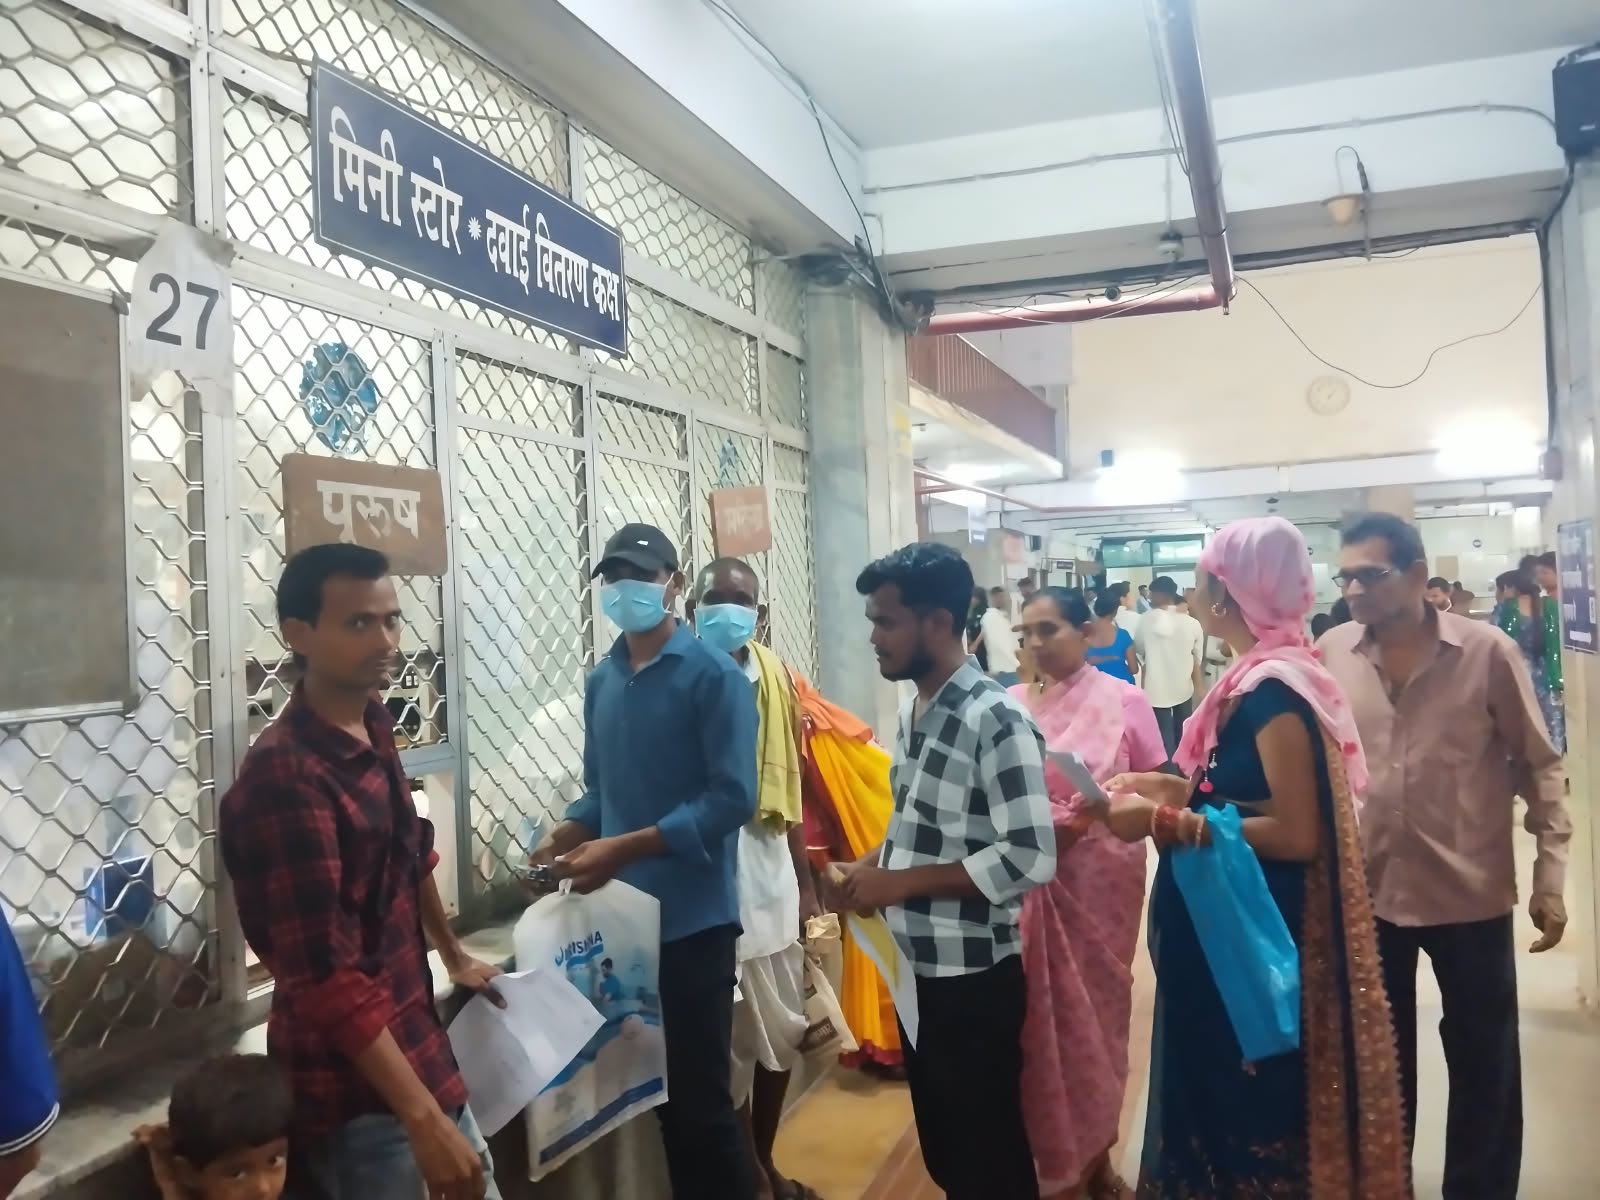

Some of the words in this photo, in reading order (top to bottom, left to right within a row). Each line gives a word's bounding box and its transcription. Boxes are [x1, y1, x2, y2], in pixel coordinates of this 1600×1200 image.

[328, 105, 404, 228] मिनी
[410, 155, 463, 256] स्टोर
[485, 203, 531, 296] दवाई
[534, 212, 589, 308] वितरण
[591, 262, 621, 322] कक्ष
[145, 272, 220, 351] 27
